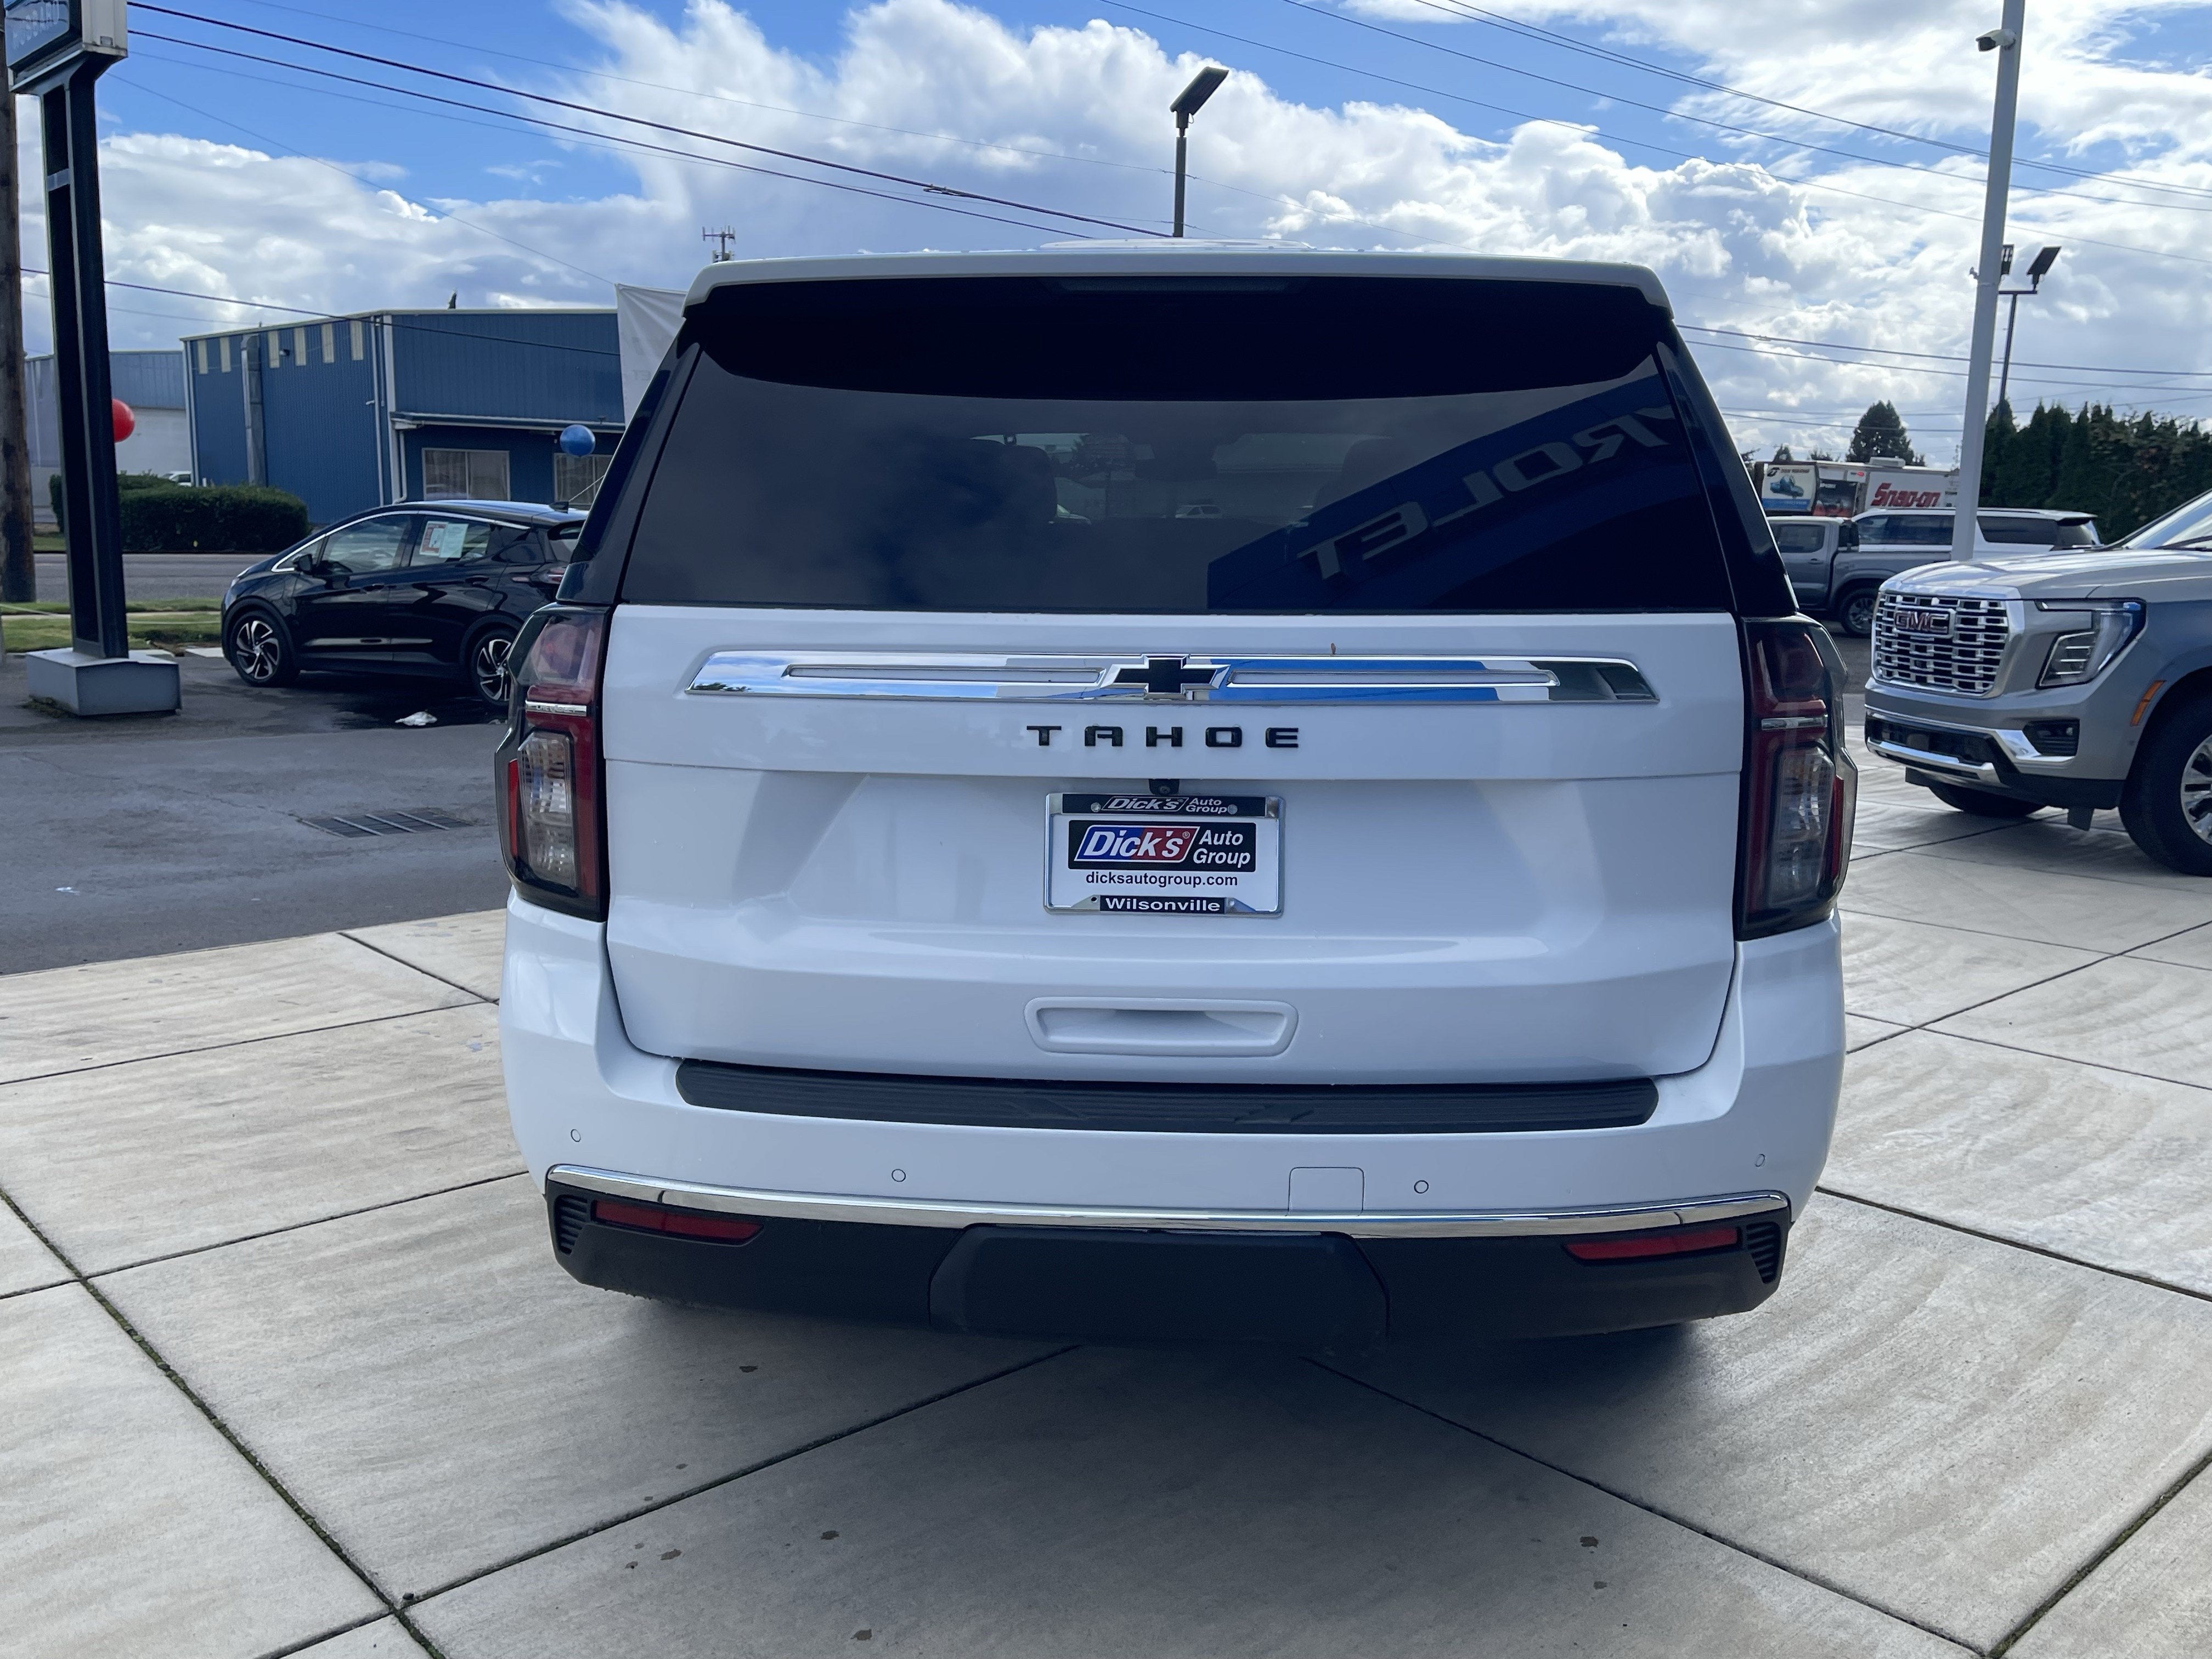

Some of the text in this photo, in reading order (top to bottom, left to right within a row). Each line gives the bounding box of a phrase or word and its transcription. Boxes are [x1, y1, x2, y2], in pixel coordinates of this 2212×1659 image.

[1870, 482, 1942, 507] Snap-on
[1895, 611, 1949, 634] GMC
[1026, 725, 1300, 748] TAHOE
[1107, 798, 1179, 810] Dick's
[1186, 805, 1228, 814] Group
[1189, 798, 1222, 806] Auto
[1083, 830, 1185, 858] Dick's
[1198, 830, 1244, 846] Auto
[1192, 848, 1251, 868] Group
[1085, 871, 1238, 888] dicksautogroup.com
[1105, 898, 1221, 912] Wilsonville
